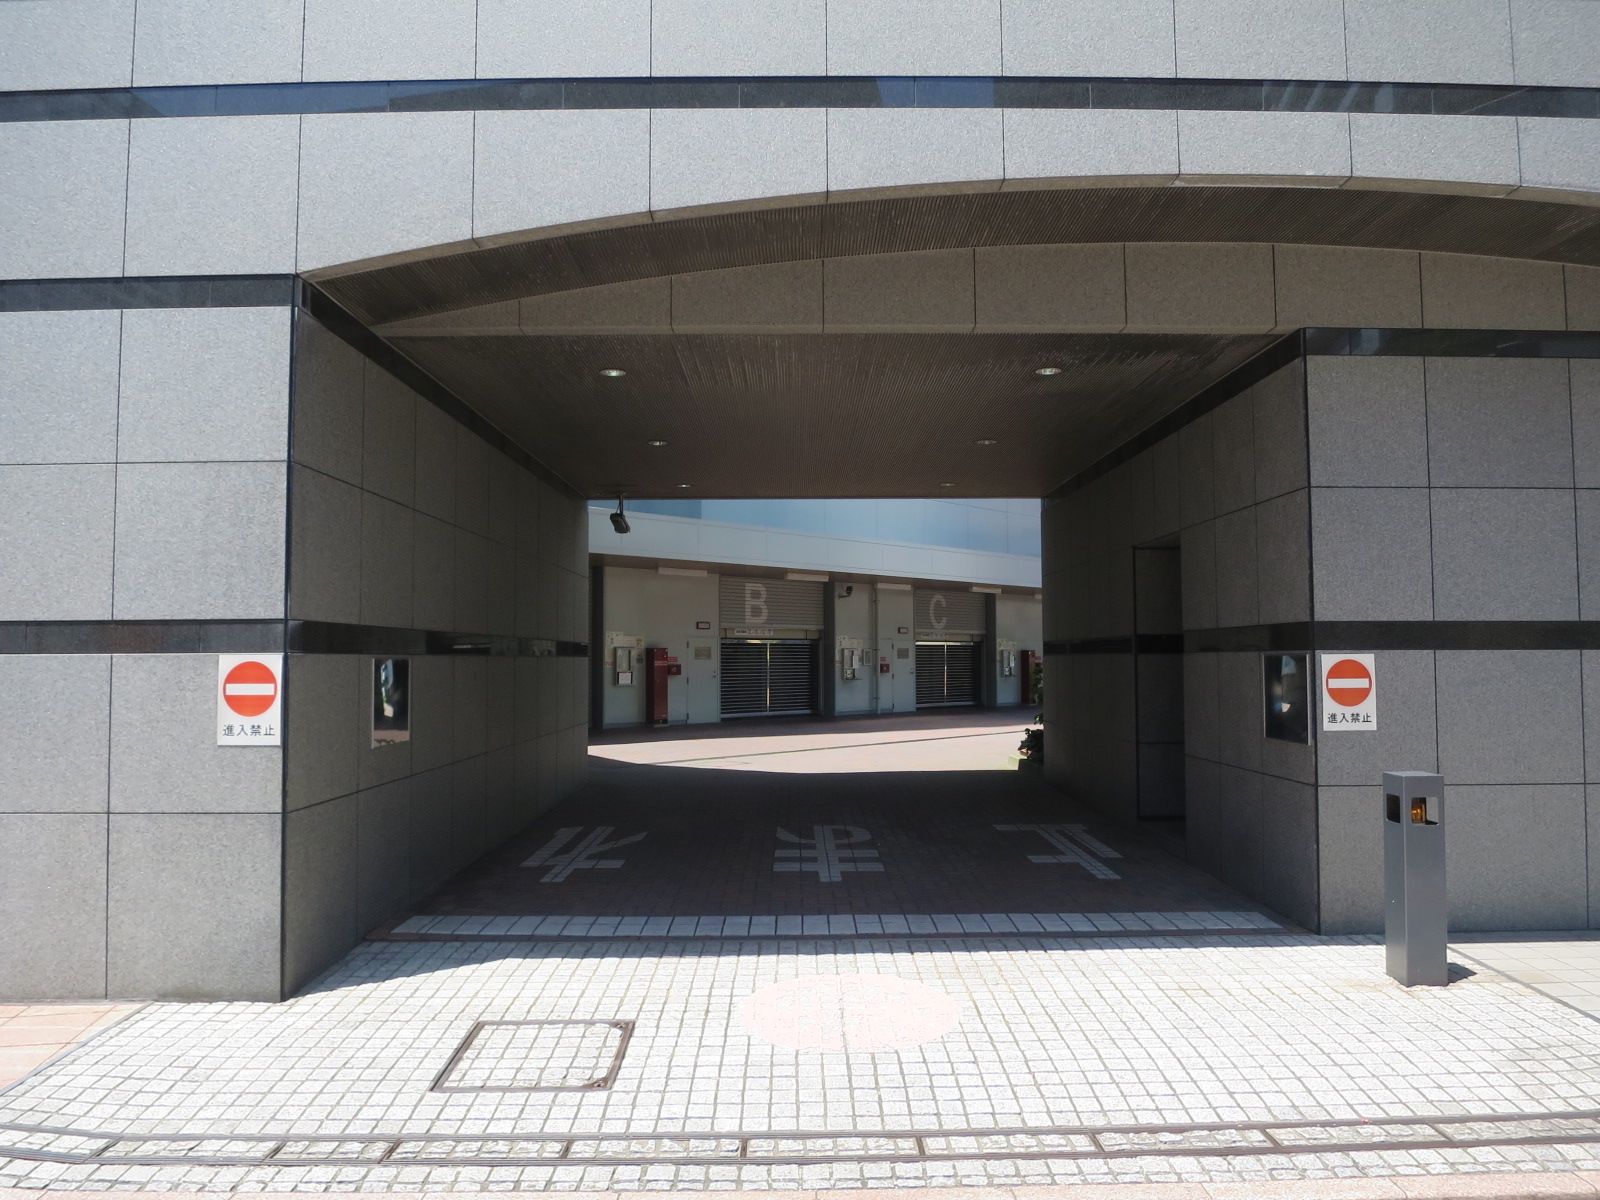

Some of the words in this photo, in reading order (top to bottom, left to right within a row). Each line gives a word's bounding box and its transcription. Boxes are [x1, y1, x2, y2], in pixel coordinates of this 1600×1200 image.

[744, 582, 769, 624] B
[929, 594, 947, 629] C
[1328, 712, 1372, 724] 進入禁止
[223, 724, 276, 737] 進入禁止
